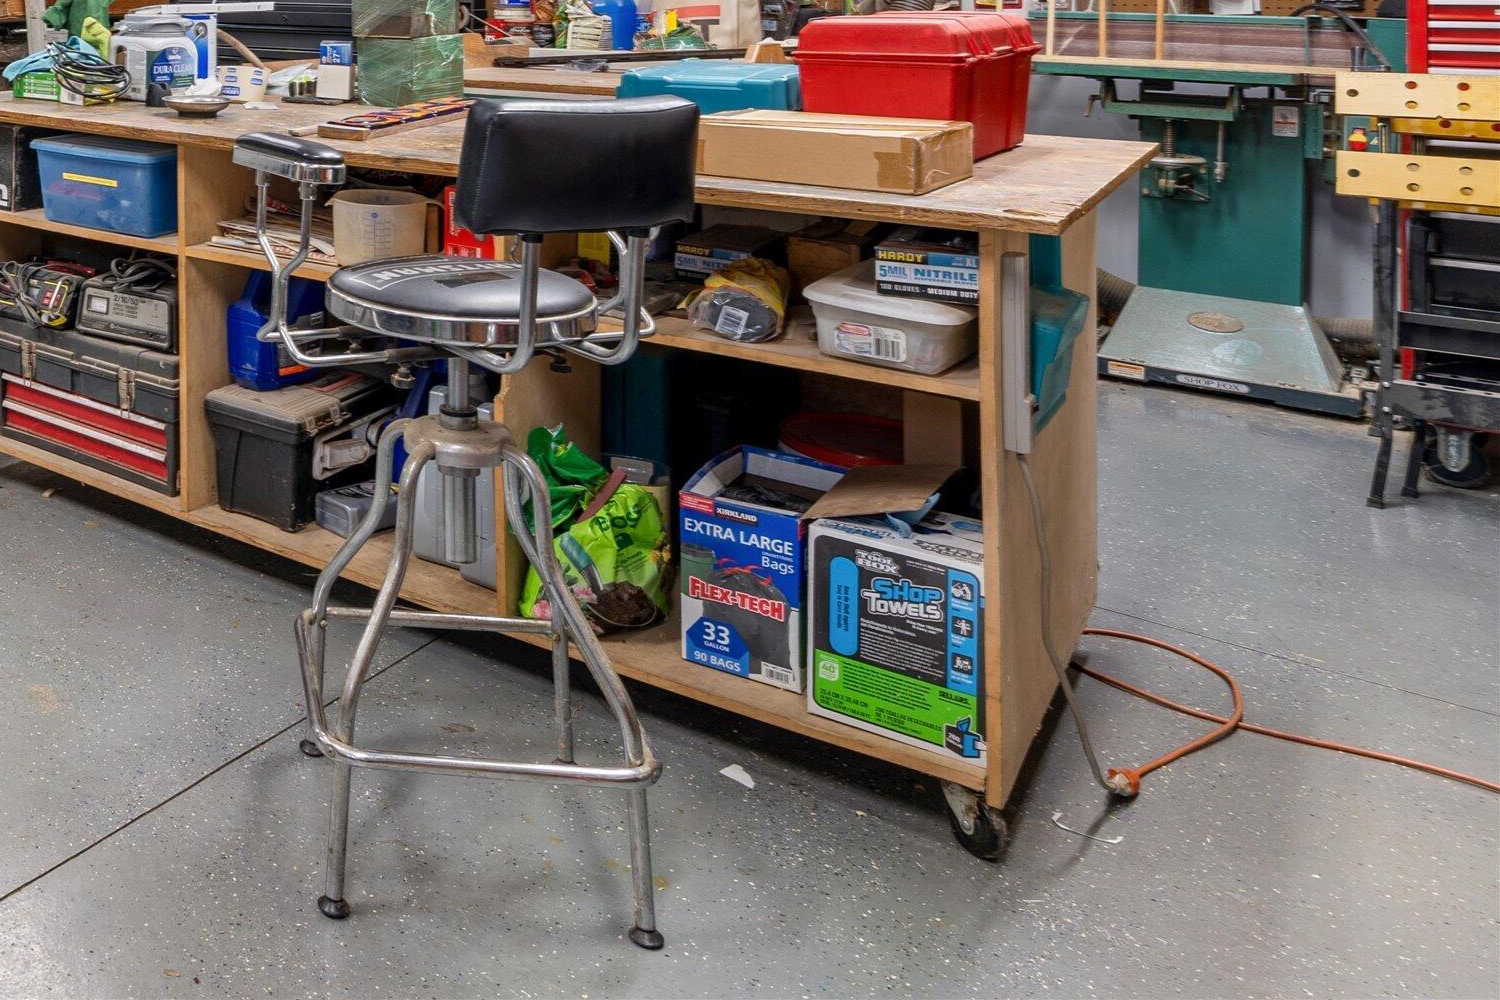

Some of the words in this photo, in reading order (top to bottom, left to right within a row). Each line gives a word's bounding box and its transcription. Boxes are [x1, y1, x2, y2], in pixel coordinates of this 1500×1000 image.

[153, 64, 173, 74] DURA
[173, 63, 194, 73] CLEAN
[677, 244, 710, 256] HARDY
[878, 250, 923, 263] HARDY
[913, 267, 977, 283] NITRILE
[894, 284, 920, 293] GLOVES
[927, 287, 958, 297] MEDIUM
[960, 291, 978, 299] DUTY
[1183, 376, 1214, 387] SHOP
[1217, 381, 1240, 392] FOX
[716, 507, 758, 522] KIRKLAND
[684, 517, 736, 542] EXTRA
[739, 530, 794, 556] LARGE
[761, 556, 794, 575] Bags
[857, 558, 899, 574] BOX
[689, 575, 785, 622] FLEX-TECH
[873, 579, 941, 603] SHOP
[862, 591, 942, 620] TOWELS
[702, 621, 730, 646] 33
[704, 640, 730, 653] GALLON
[694, 650, 708, 662] 90
[710, 655, 741, 672] BAGS
